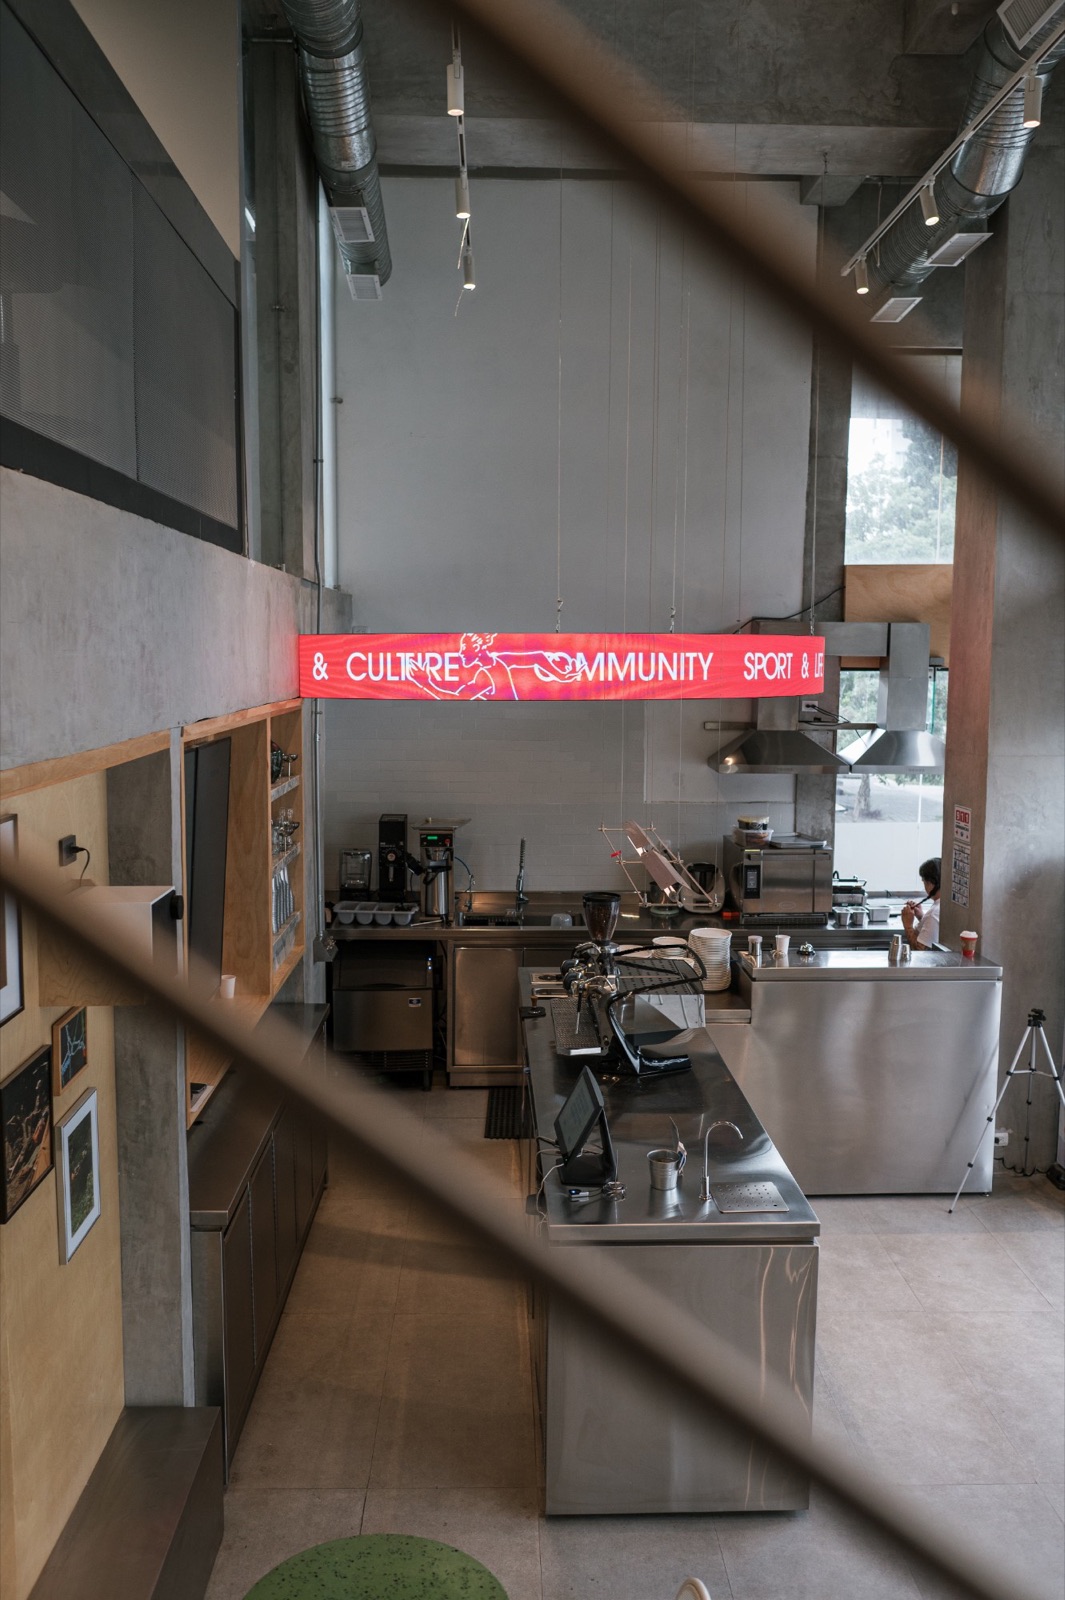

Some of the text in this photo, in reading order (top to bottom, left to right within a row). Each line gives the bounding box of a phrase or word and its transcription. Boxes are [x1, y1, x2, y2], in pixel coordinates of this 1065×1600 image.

[312, 652, 329, 681] &
[346, 652, 460, 681] CULTURE
[743, 652, 793, 680] SPORT
[801, 652, 809, 679] &
